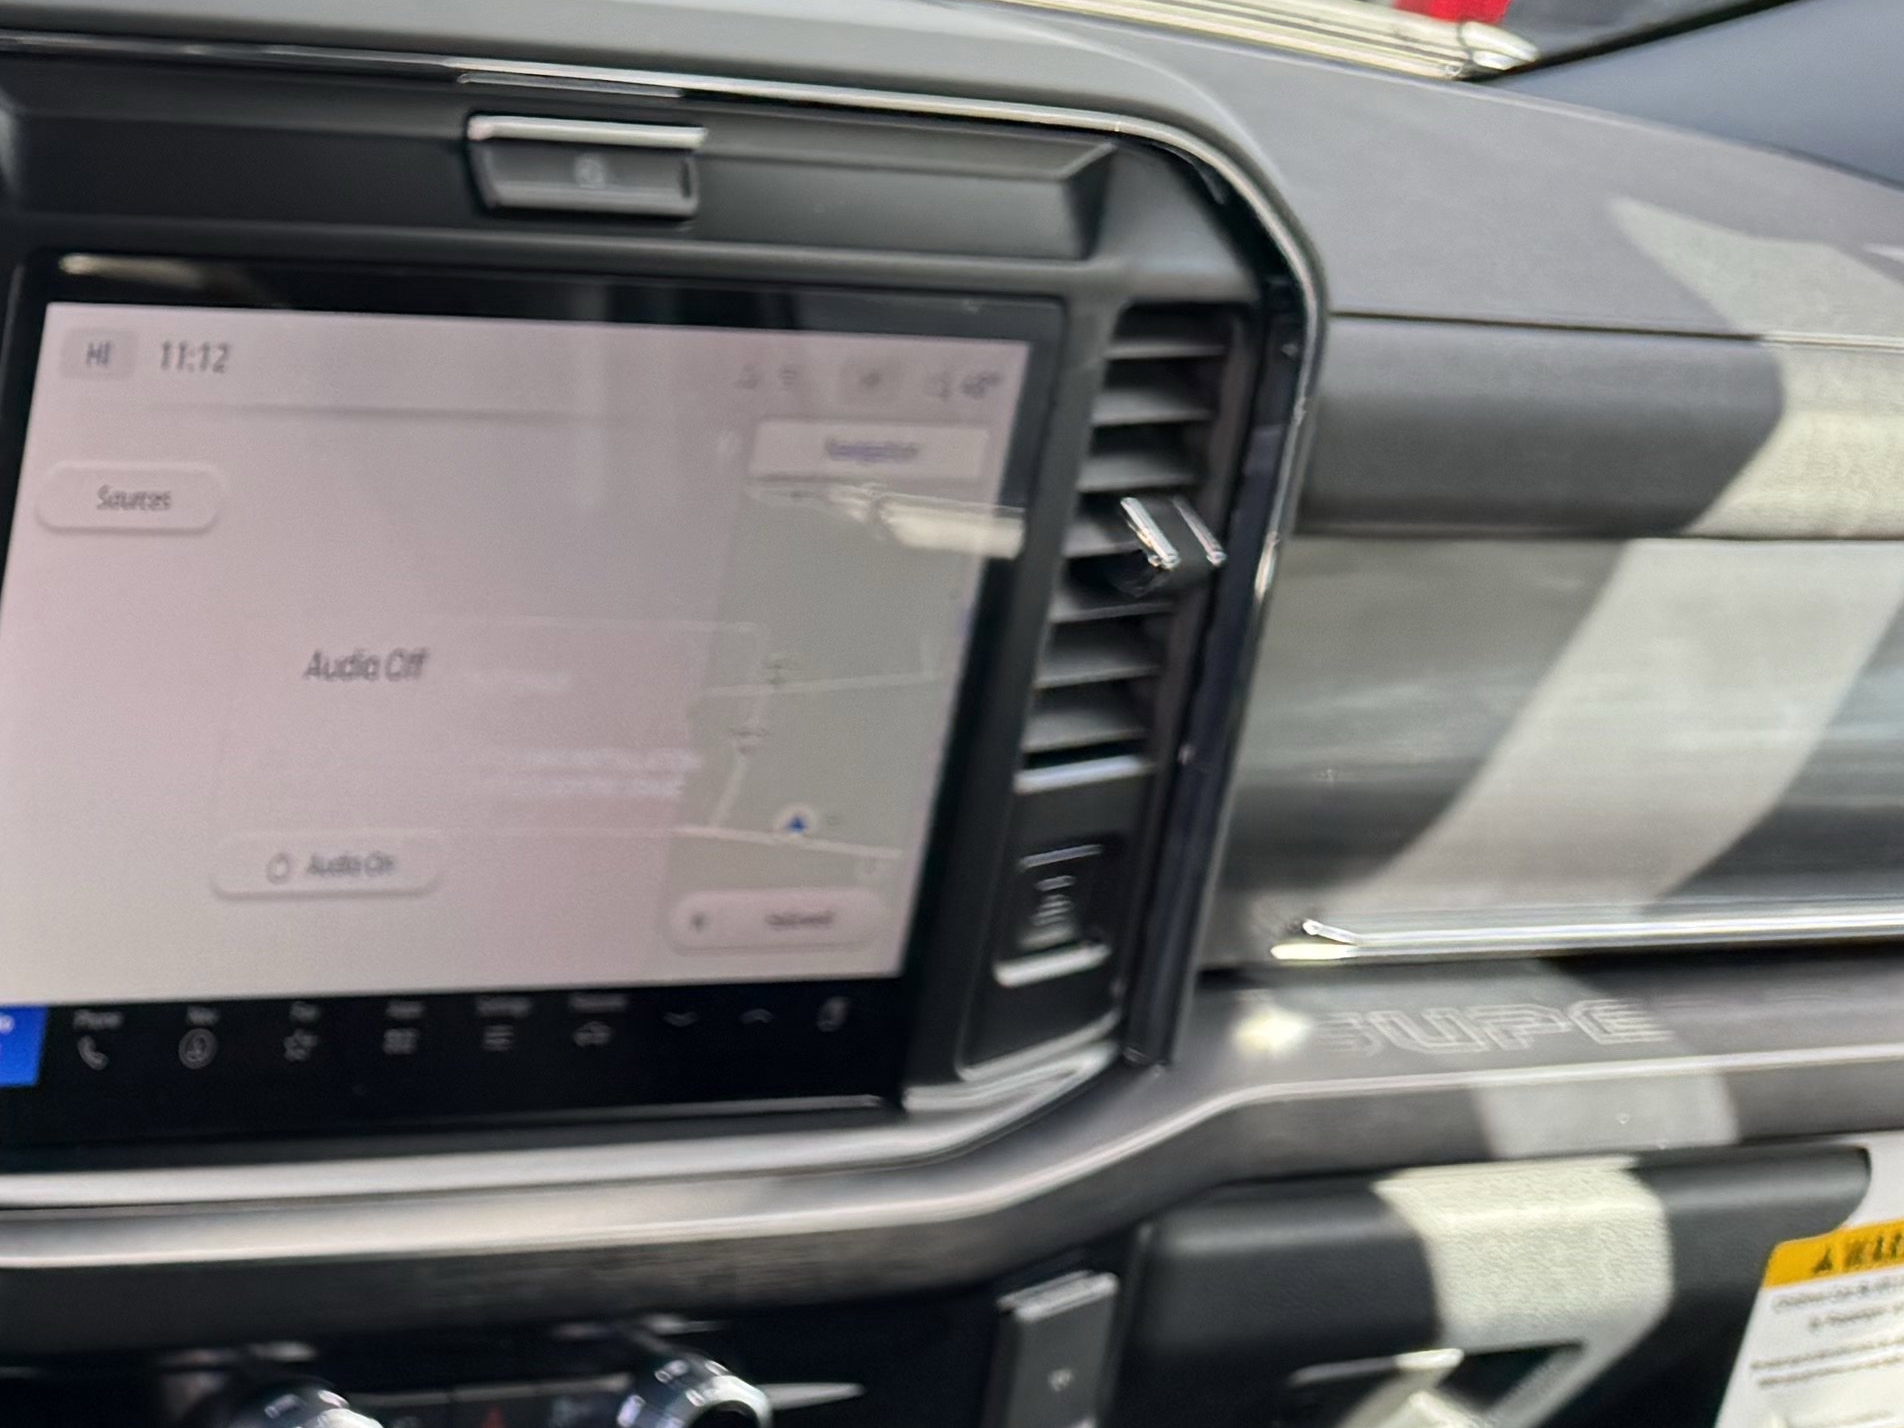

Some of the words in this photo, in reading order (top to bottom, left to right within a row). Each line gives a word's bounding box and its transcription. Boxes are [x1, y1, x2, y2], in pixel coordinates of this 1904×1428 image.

[160, 340, 231, 373] 11:12
[96, 484, 172, 511] Sources
[302, 647, 382, 682] Audio
[384, 646, 430, 682] Off
